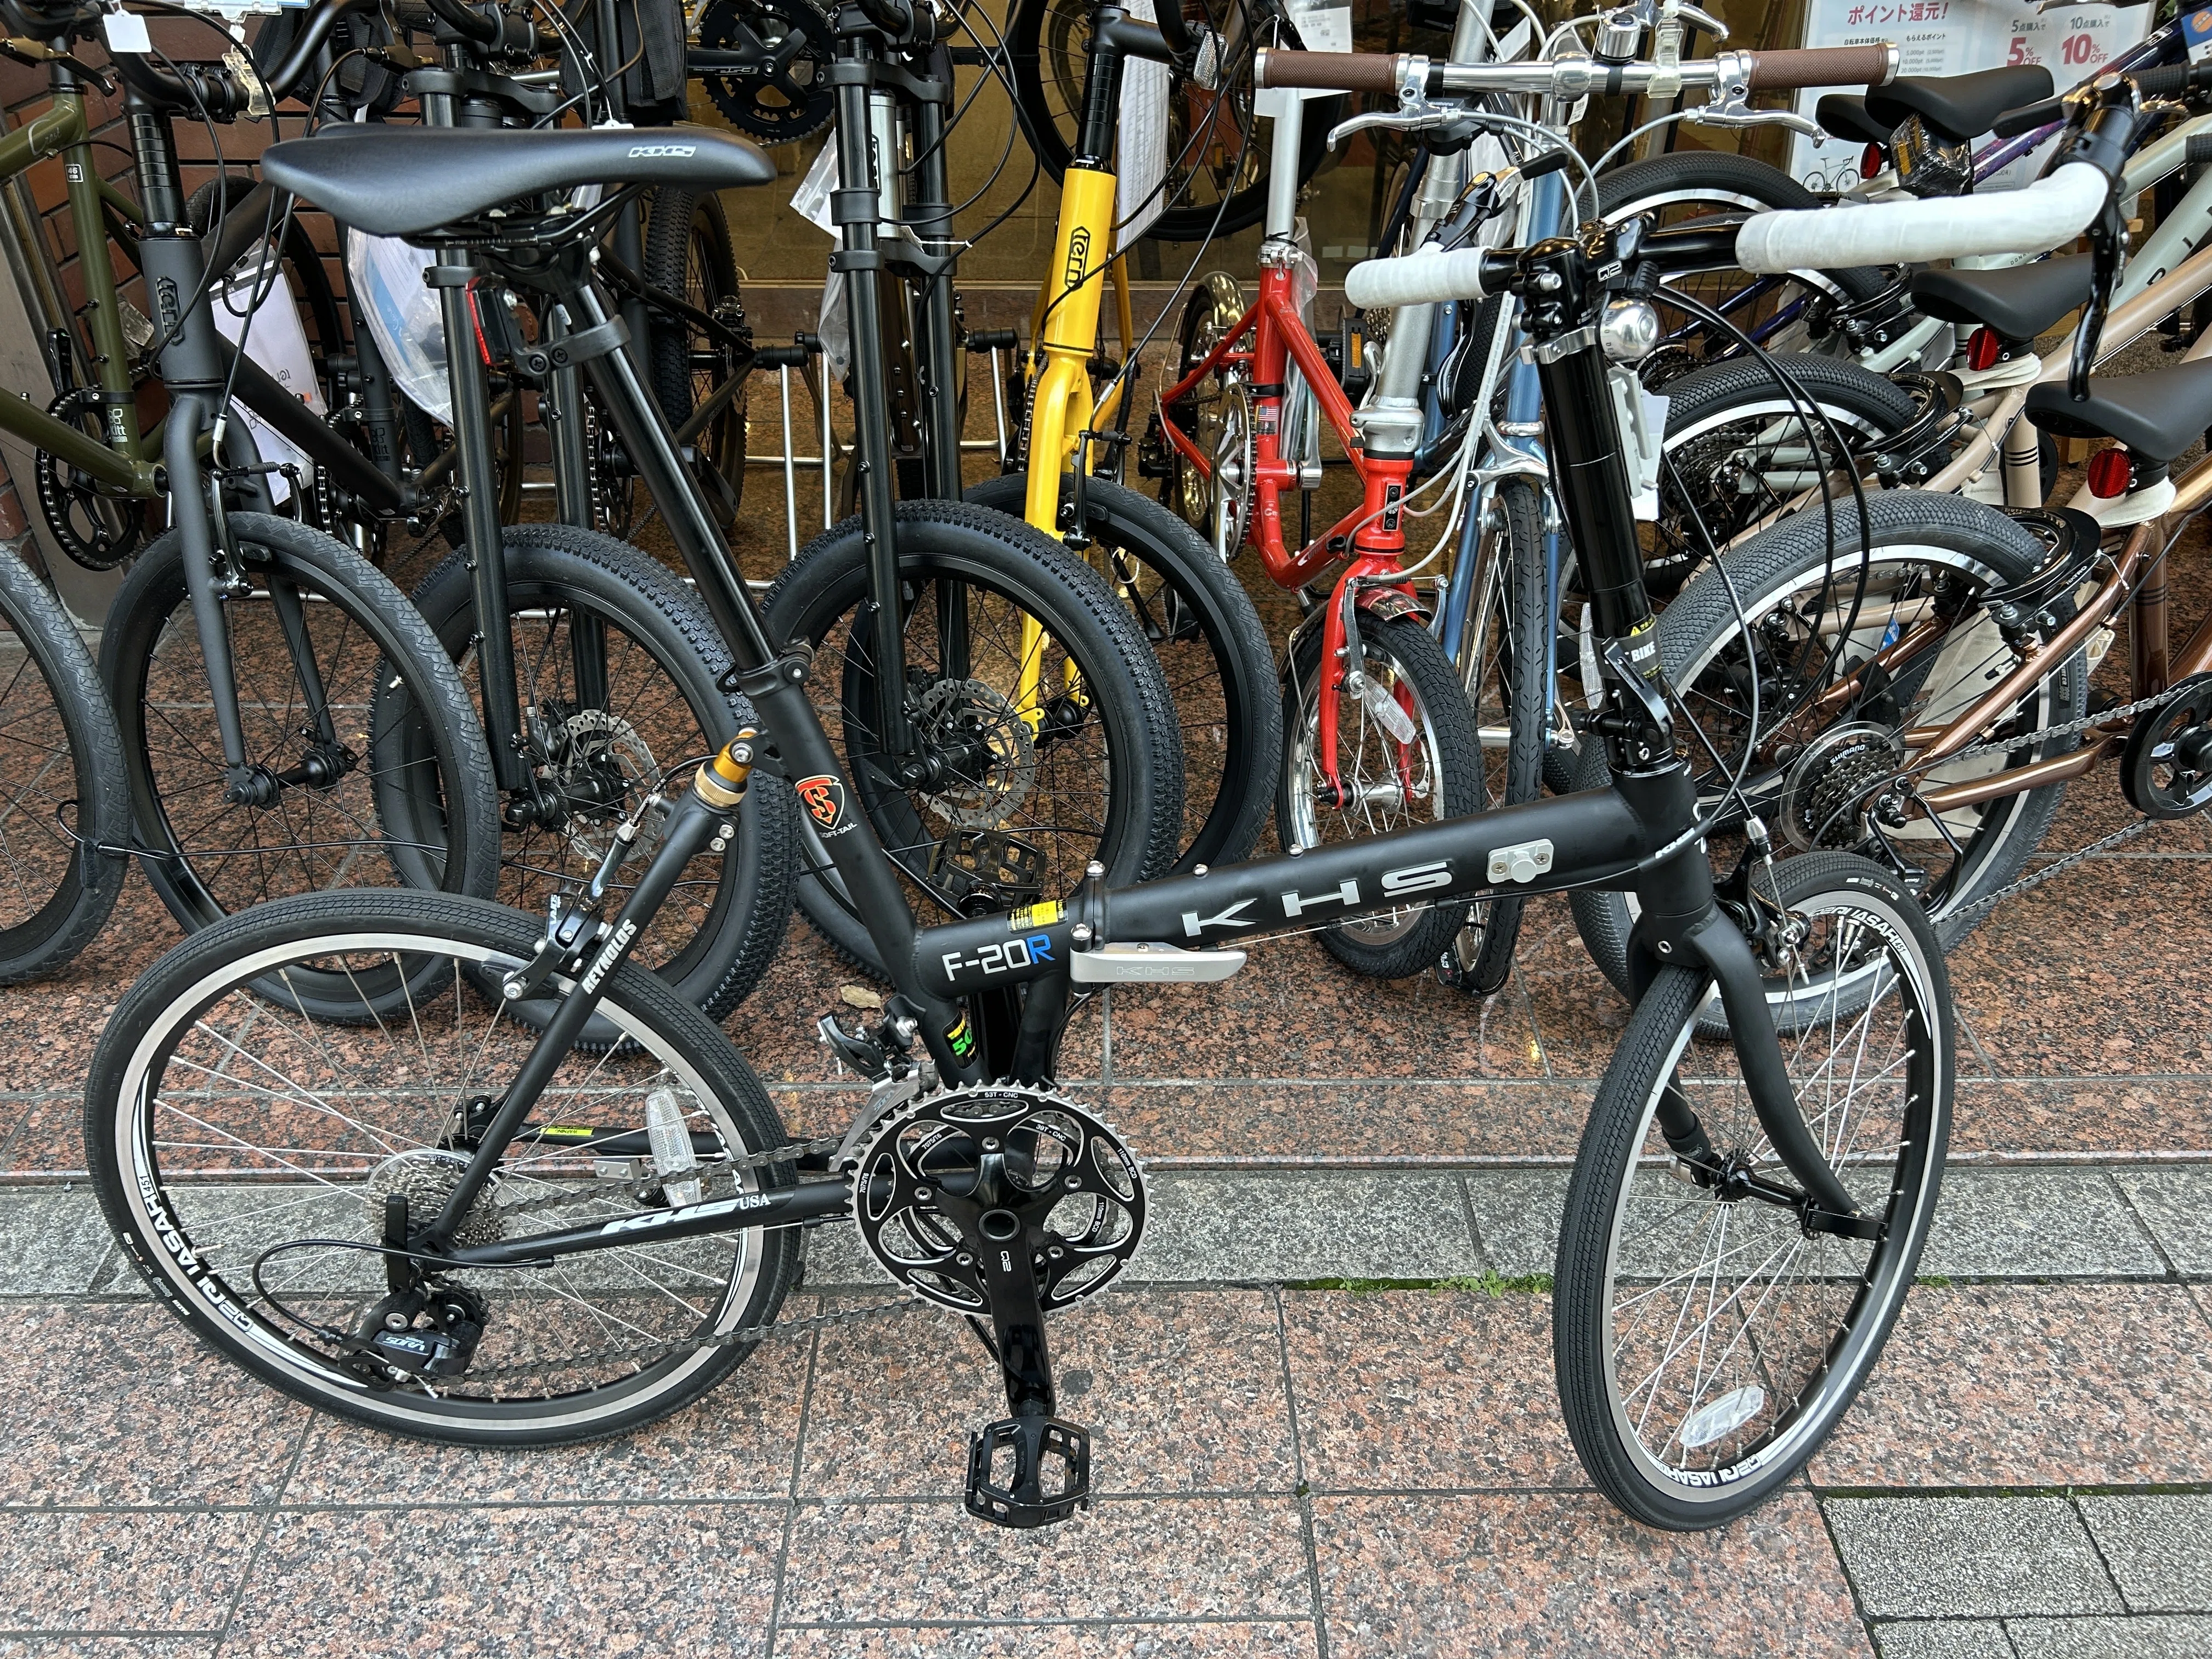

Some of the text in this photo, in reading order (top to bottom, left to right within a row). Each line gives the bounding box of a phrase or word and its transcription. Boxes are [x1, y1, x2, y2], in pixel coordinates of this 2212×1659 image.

[2090, 53, 2108, 64] OFF
[1830, 744, 1866, 765] SHIMANO
[1181, 860, 1453, 937] KHS
[582, 918, 637, 995] REYNOLDS
[941, 933, 1056, 983] F-20R
[1116, 966, 1195, 977] KHS
[139, 1175, 151, 1192] 451
[740, 1193, 771, 1210] USA
